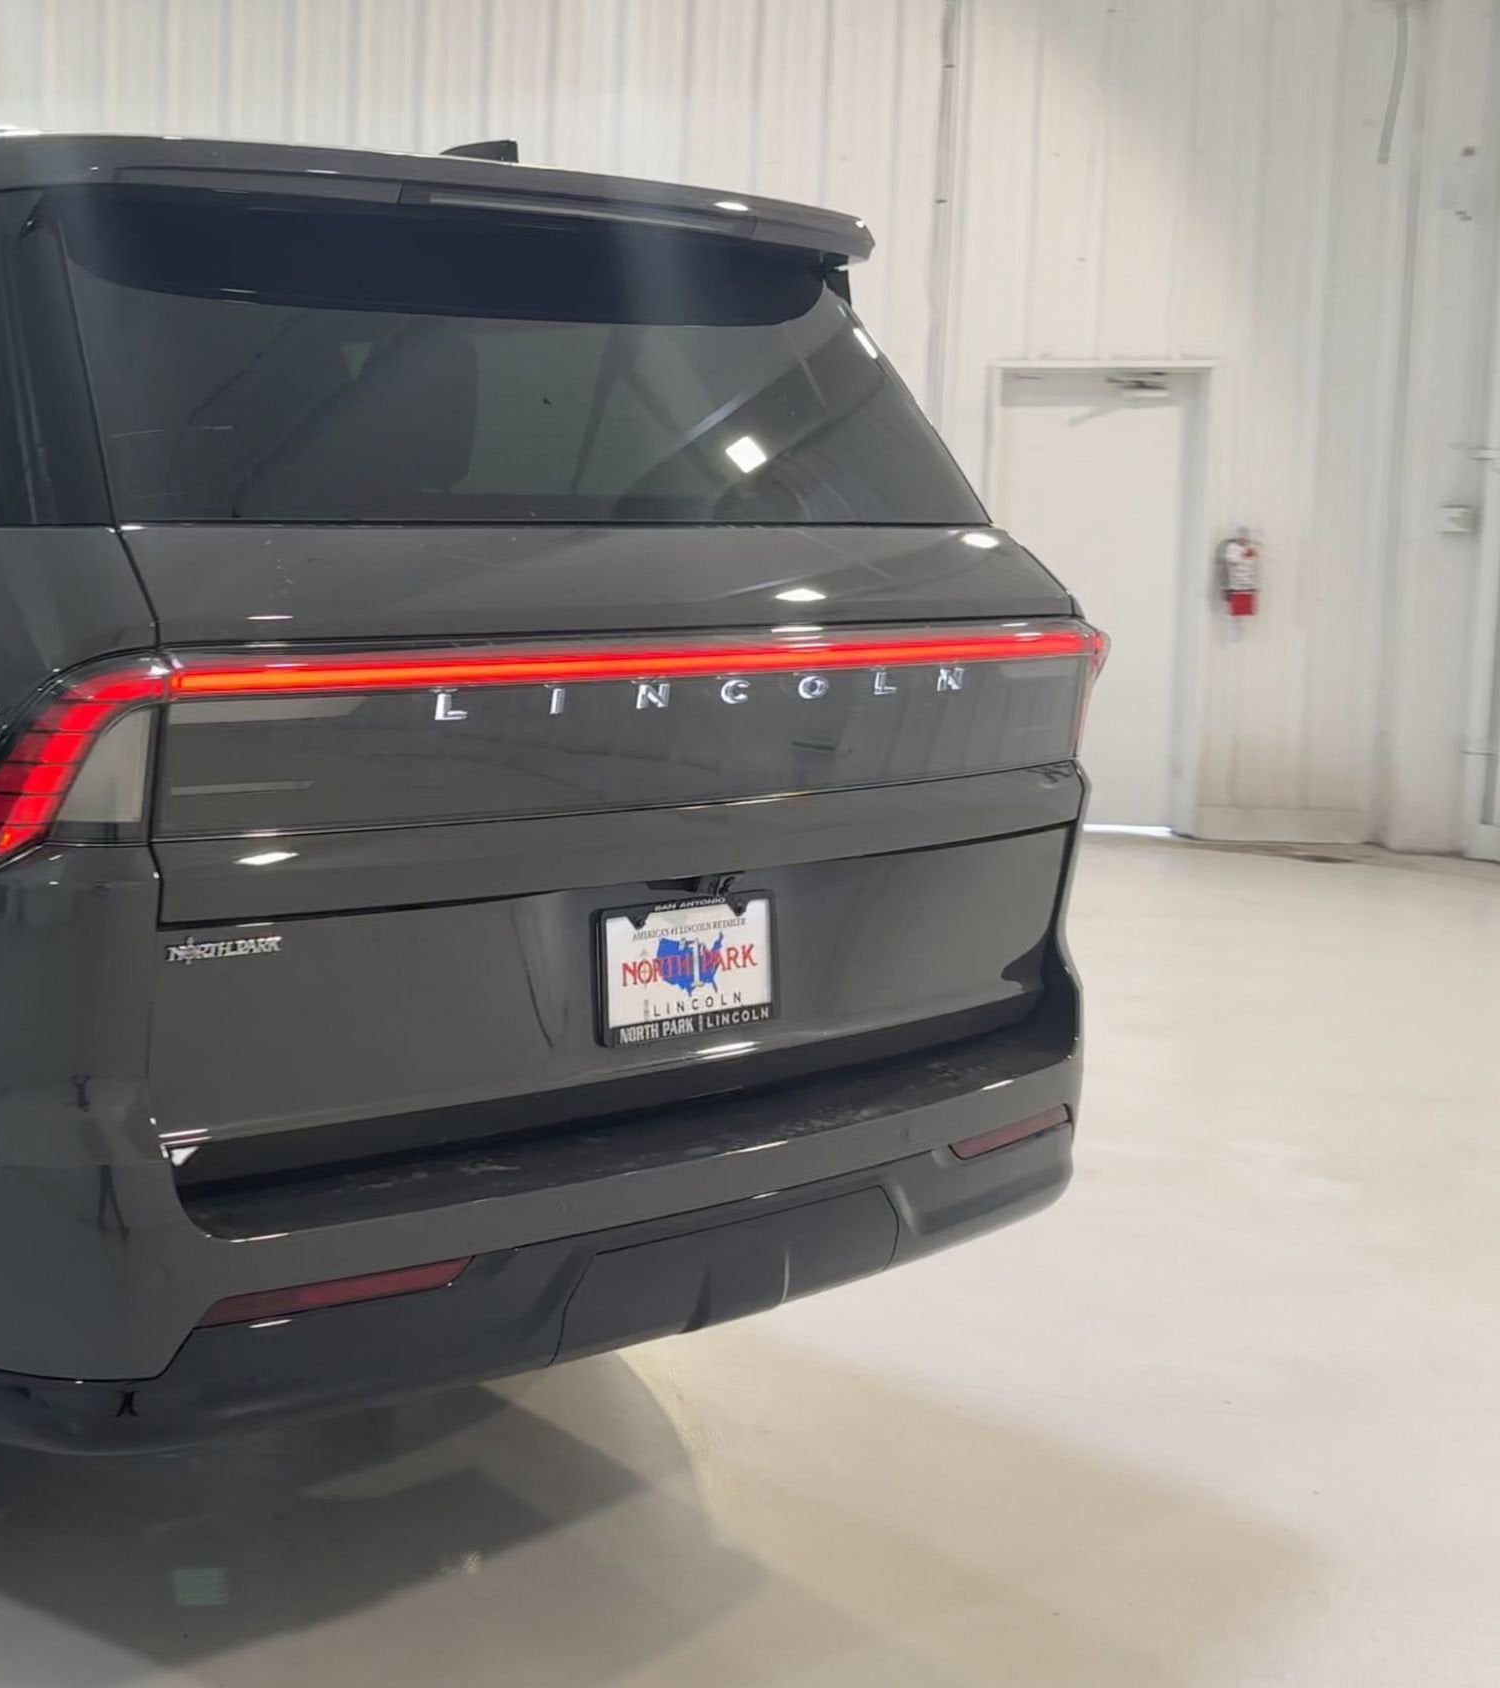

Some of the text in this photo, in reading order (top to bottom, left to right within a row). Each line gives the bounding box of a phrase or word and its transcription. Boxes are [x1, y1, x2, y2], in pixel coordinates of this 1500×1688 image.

[435, 666, 965, 721] LINCOLN
[654, 897, 726, 912] SAN ANTONIO
[679, 922, 711, 934] LINCOLN
[712, 917, 746, 929] RETAILER
[230, 936, 282, 957] PARK
[622, 943, 757, 987] NORTH PARK
[653, 991, 742, 1017] LINCOLN
[619, 1006, 770, 1044] NORTH PARK LINCOLN
